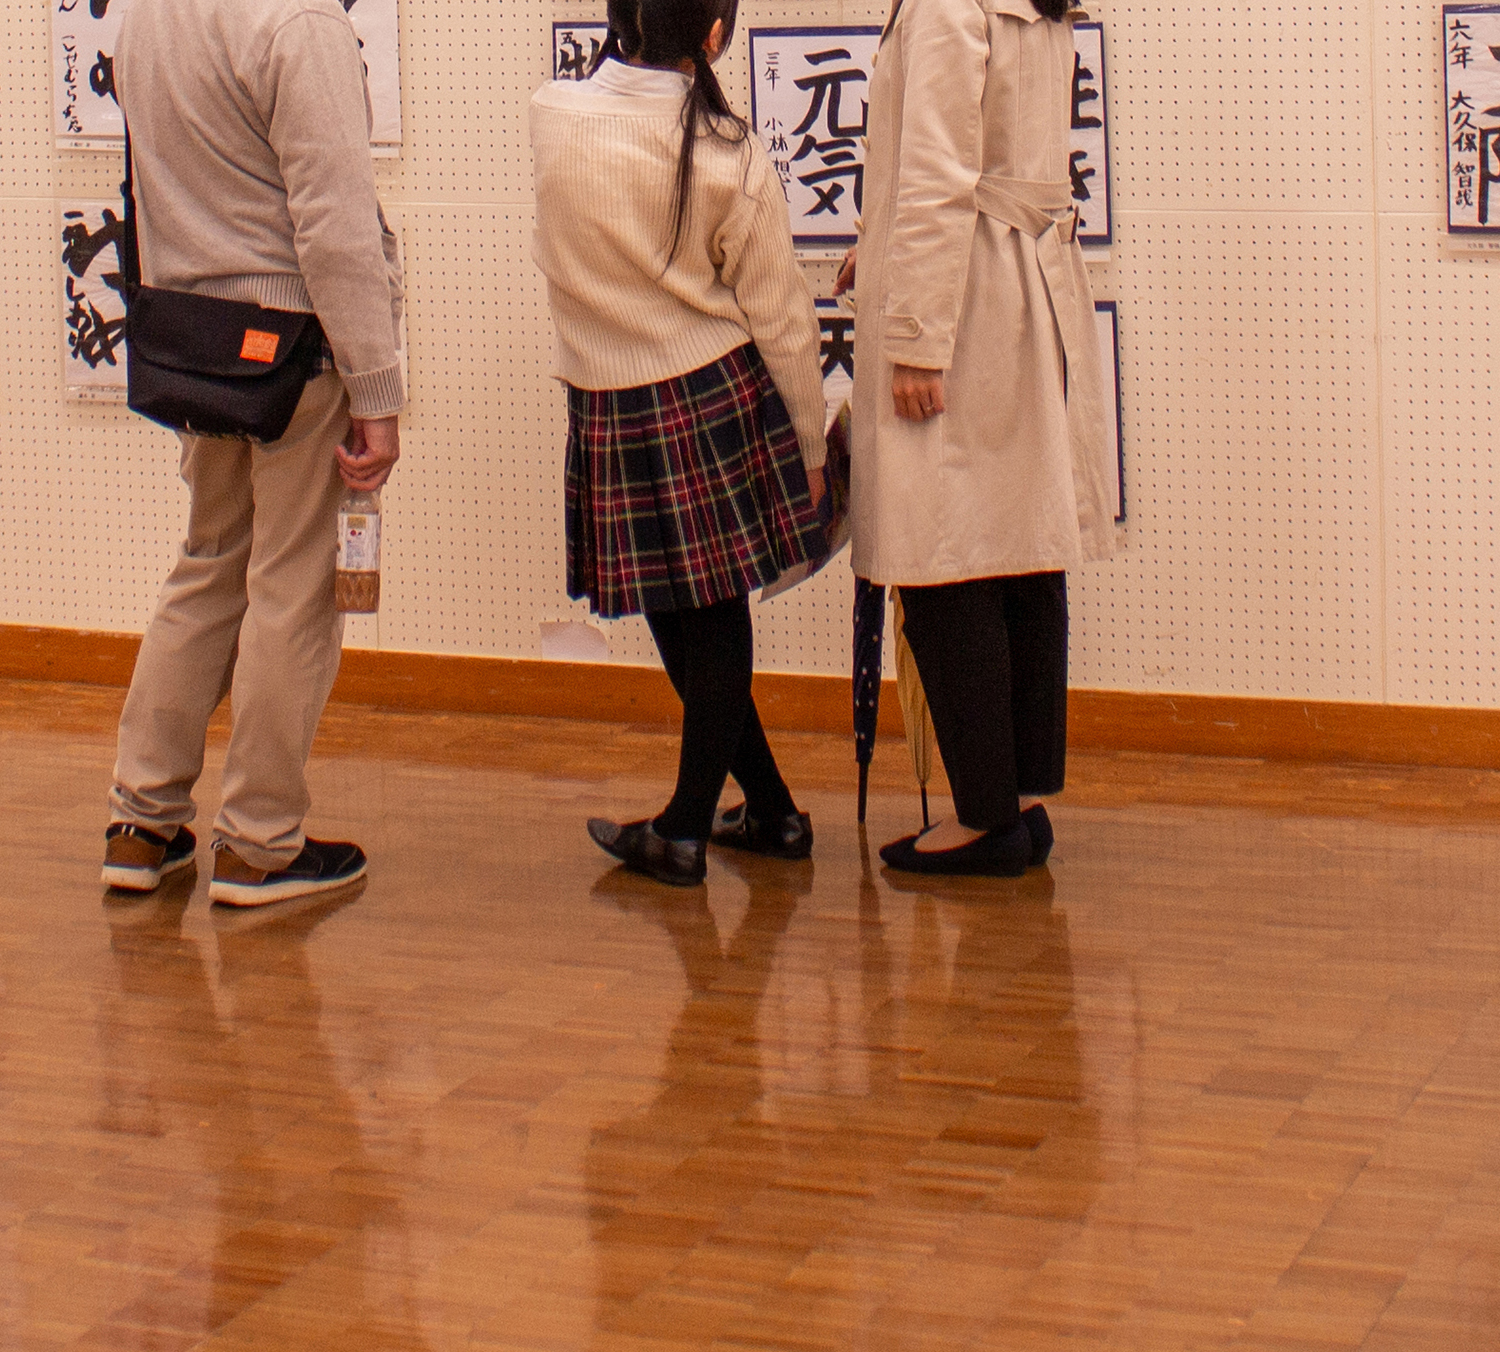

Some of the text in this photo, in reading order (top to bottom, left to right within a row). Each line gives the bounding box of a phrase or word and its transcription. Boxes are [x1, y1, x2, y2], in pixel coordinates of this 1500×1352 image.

[1449, 19, 1473, 69] 六年
[764, 51, 781, 92] 三年
[790, 48, 868, 218] 元気
